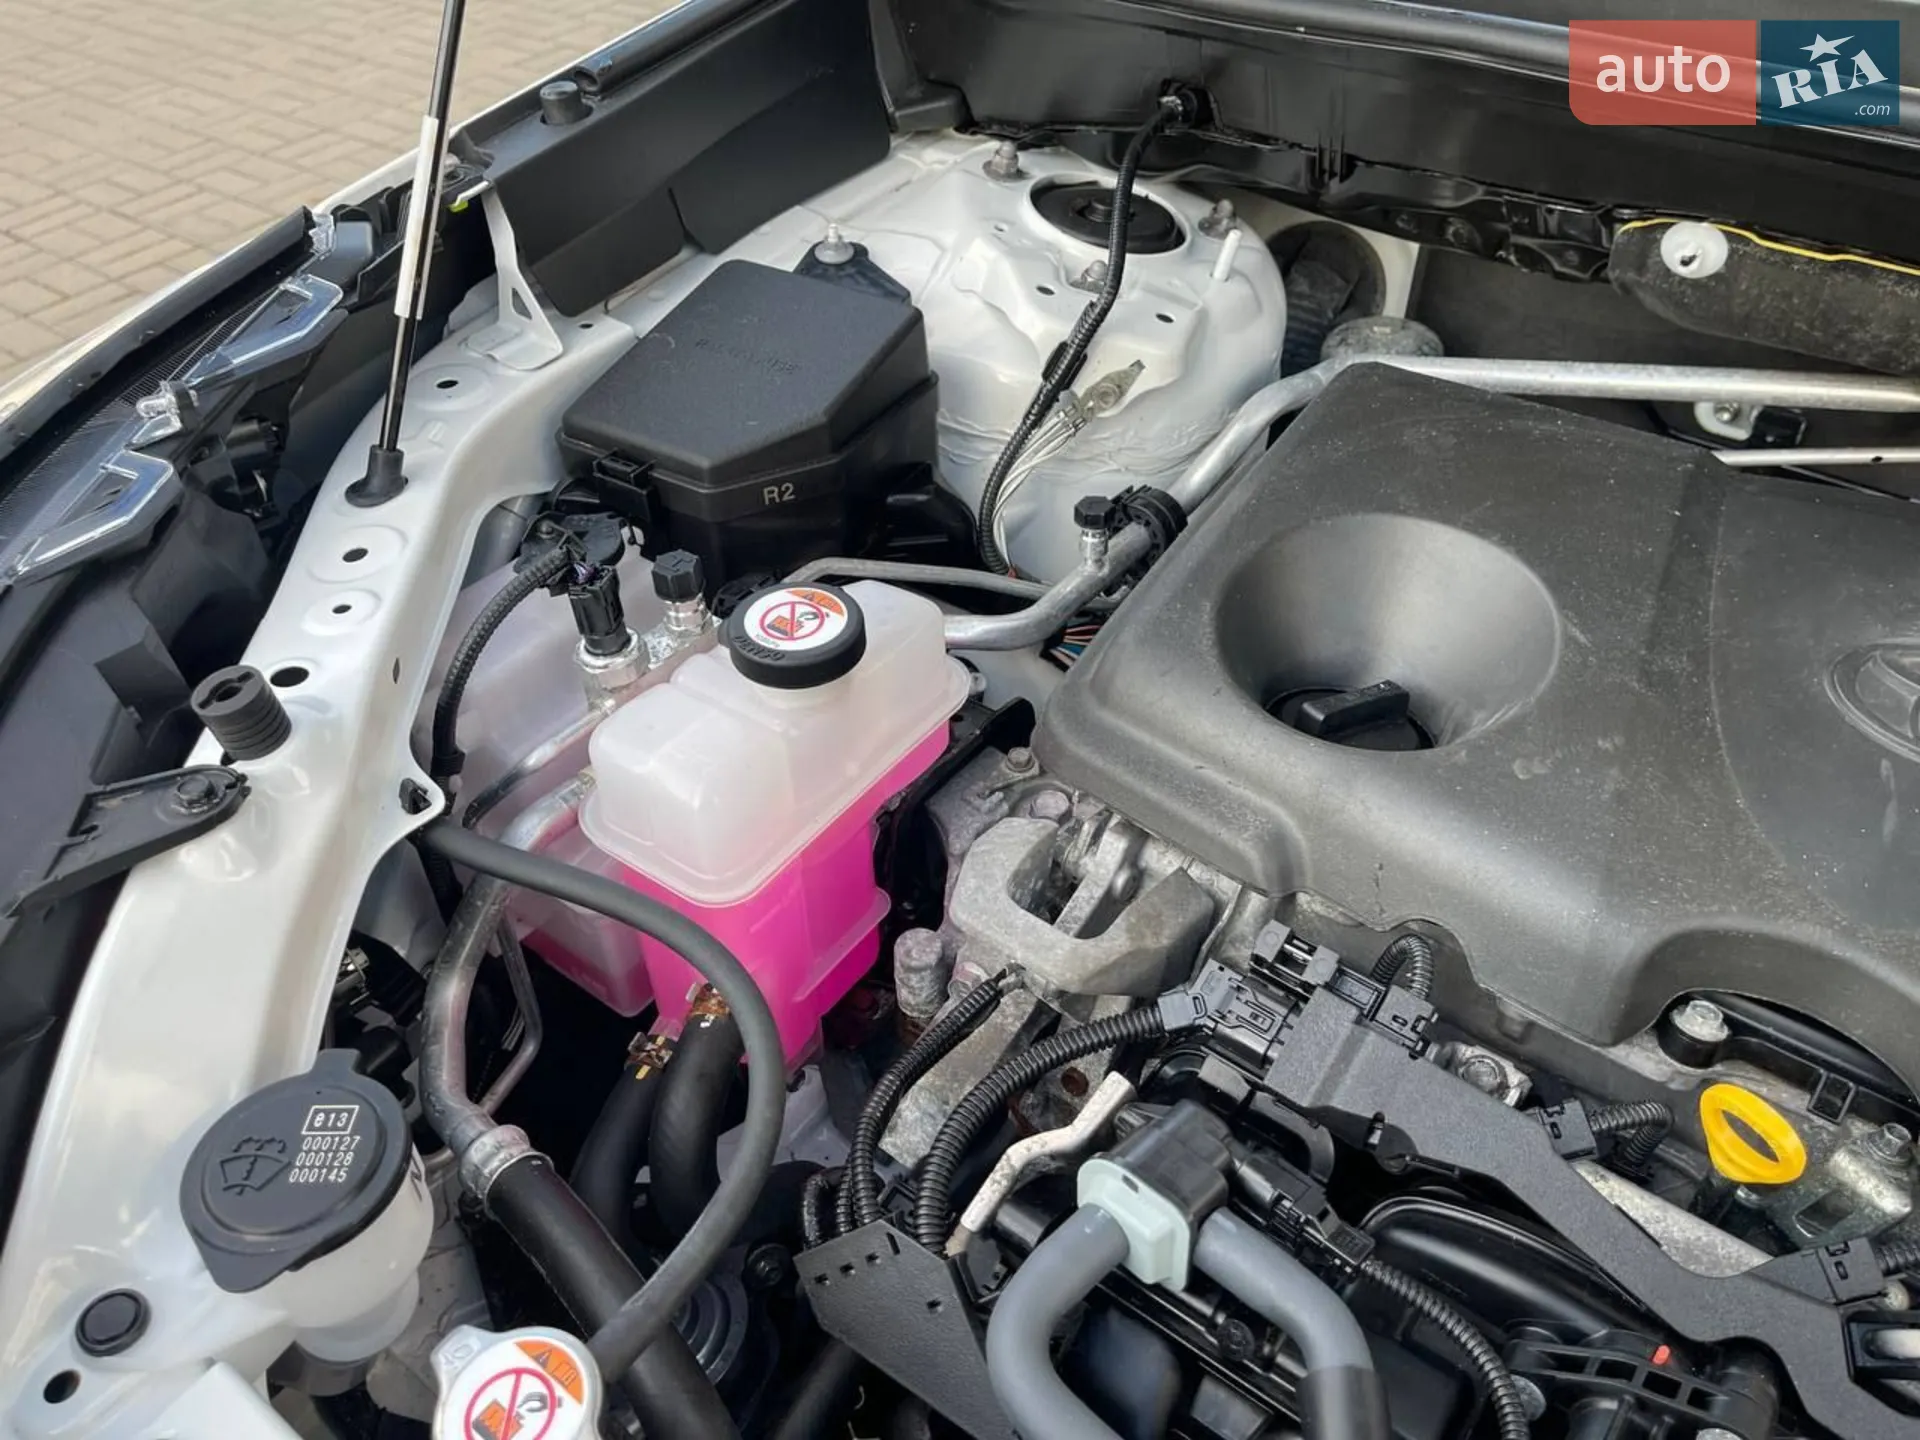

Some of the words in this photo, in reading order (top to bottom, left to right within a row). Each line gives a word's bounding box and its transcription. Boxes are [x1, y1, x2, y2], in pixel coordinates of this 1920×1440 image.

[764, 482, 796, 505] R2
[313, 1112, 348, 1128] e13
[302, 1136, 361, 1151] 000127
[295, 1152, 355, 1166] 000128
[288, 1168, 348, 1183] 000145
